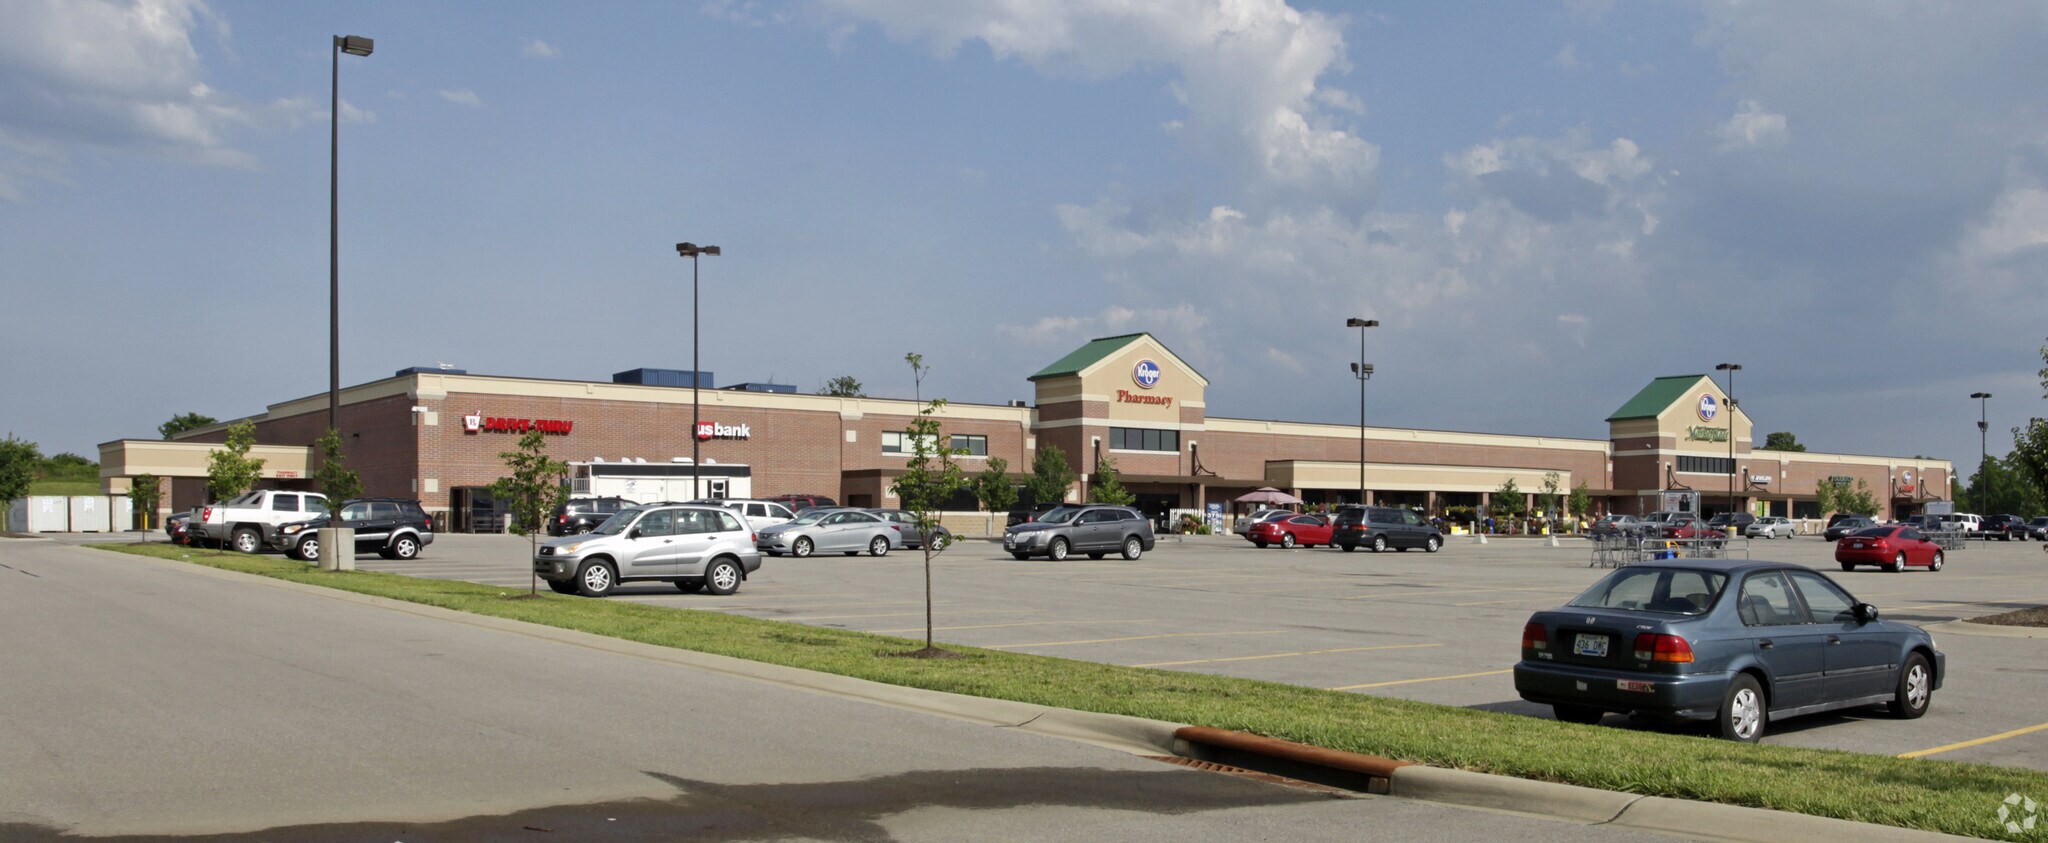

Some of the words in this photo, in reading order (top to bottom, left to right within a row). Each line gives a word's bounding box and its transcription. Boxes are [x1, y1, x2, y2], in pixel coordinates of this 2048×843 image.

[1137, 363, 1160, 384] Kroger
[1116, 389, 1173, 409] Pharmacy
[484, 417, 573, 433] DRIVE-THRU
[1576, 639, 1590, 650] 436
